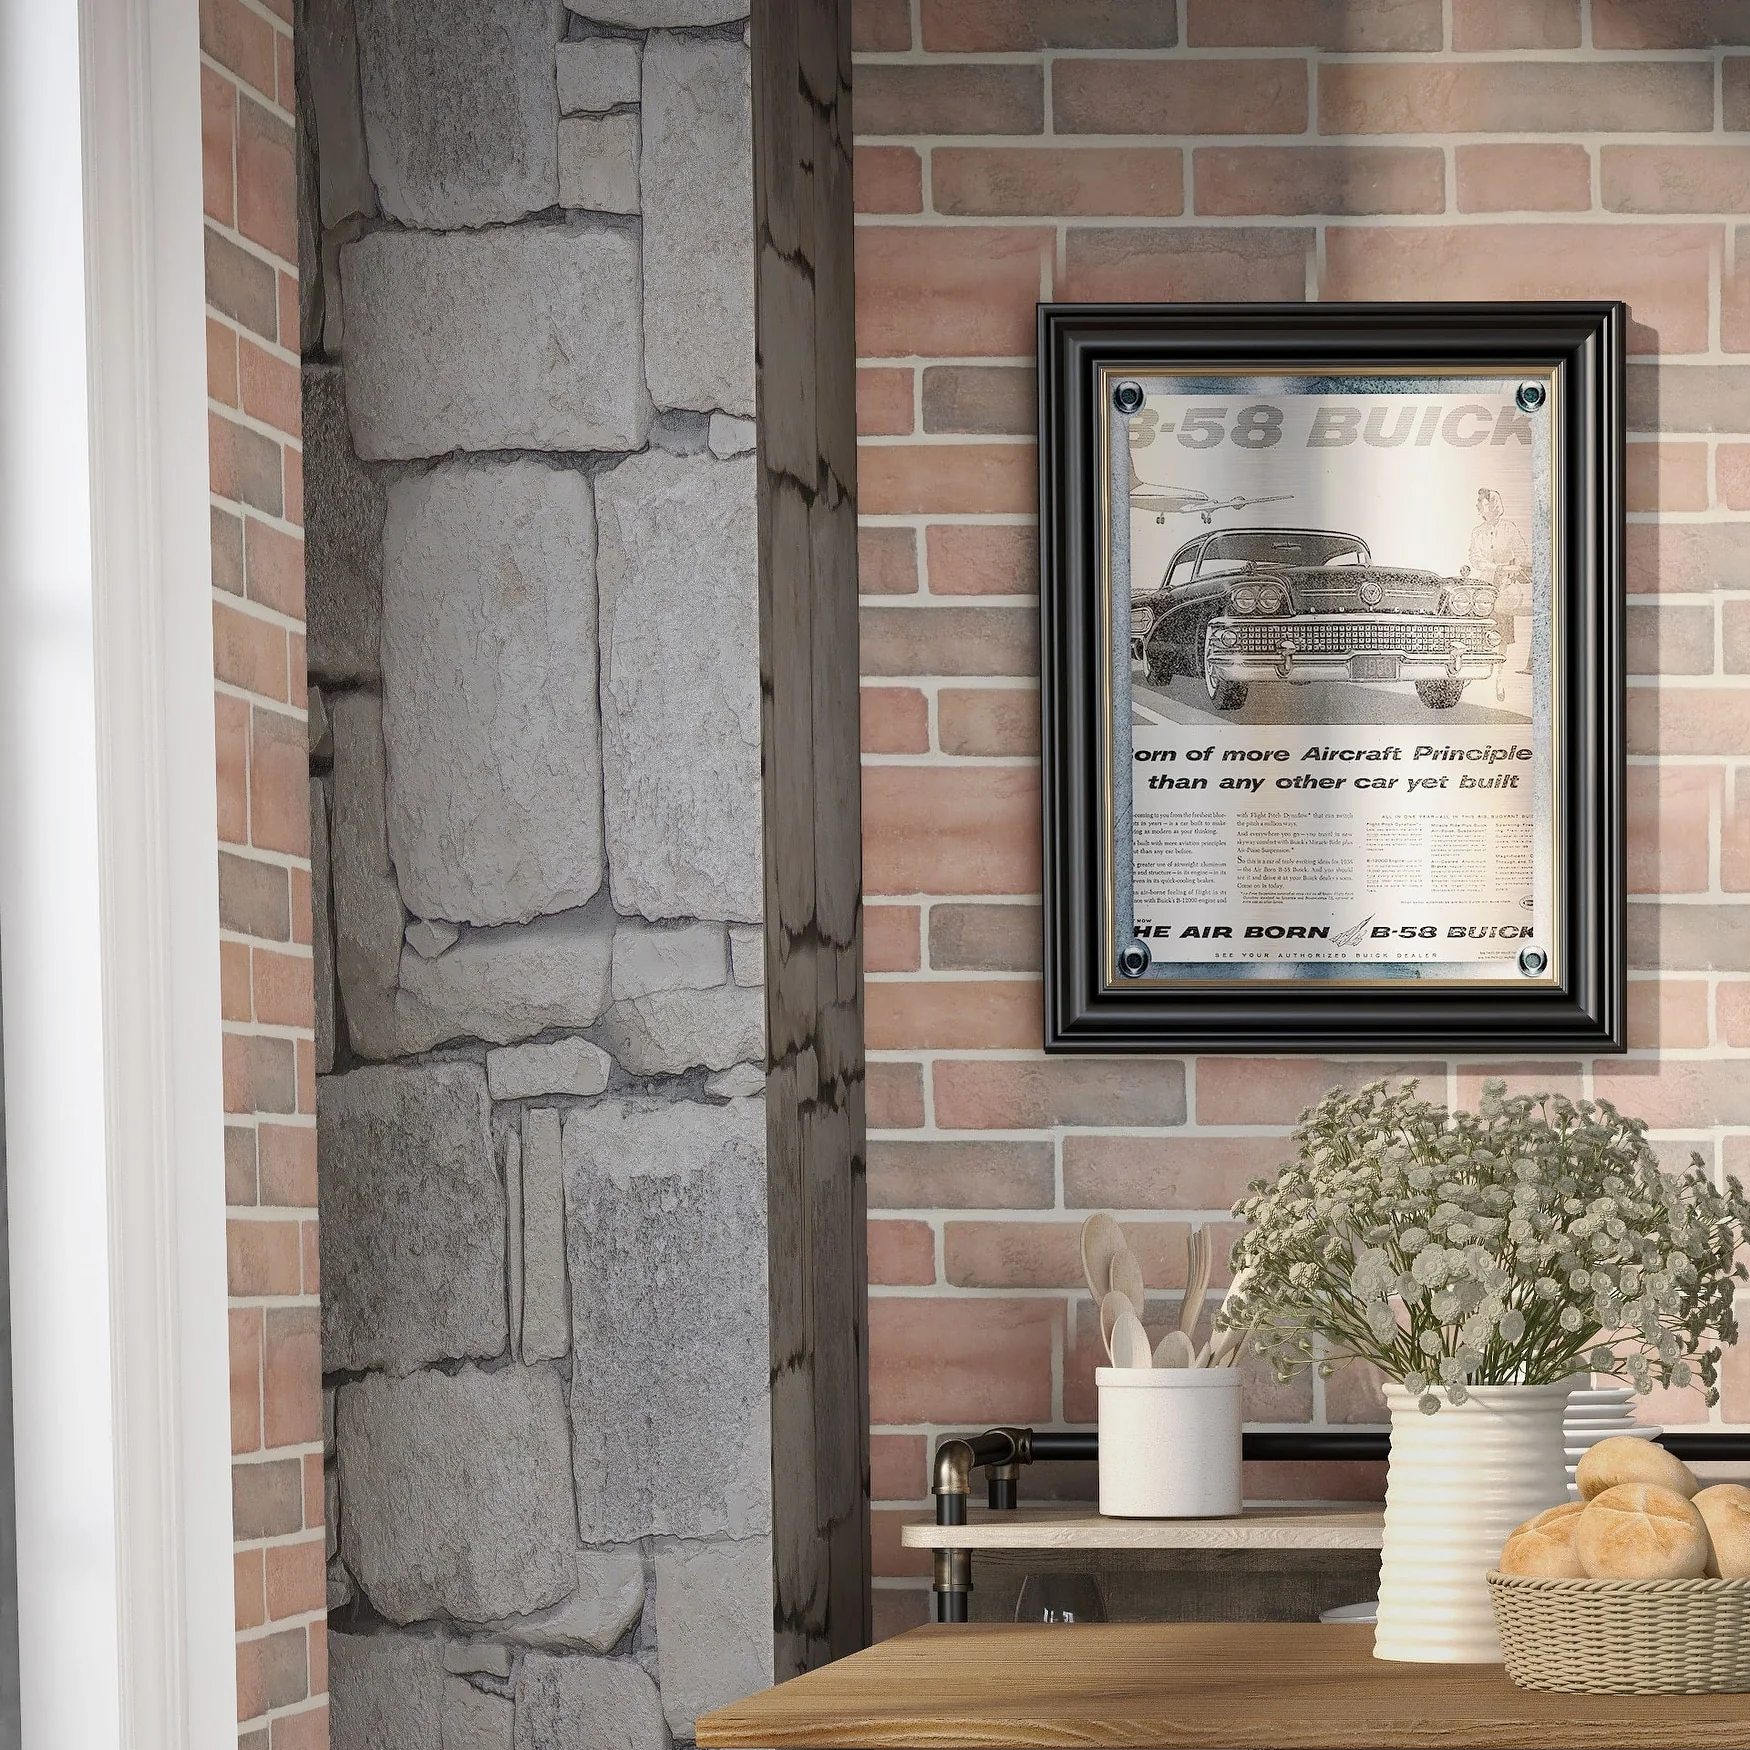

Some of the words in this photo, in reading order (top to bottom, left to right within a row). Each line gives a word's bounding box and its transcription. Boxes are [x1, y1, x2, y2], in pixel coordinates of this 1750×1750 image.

[1306, 404, 1532, 448] BUICK
[1132, 748, 1177, 761] orn
[1185, 746, 1215, 762] of
[1222, 750, 1290, 762] more
[1301, 746, 1402, 761] Aircraft
[1413, 745, 1533, 764] Principle
[1148, 774, 1208, 789] than
[1219, 778, 1266, 792] any
[1275, 774, 1347, 789] other
[1354, 777, 1399, 789] car
[1407, 776, 1449, 792] yet
[1459, 774, 1520, 789] built
[1180, 926, 1232, 938] AIR
[1244, 926, 1330, 938] BORN
[1370, 926, 1438, 938] B-58
[1447, 926, 1534, 938] BUICK
